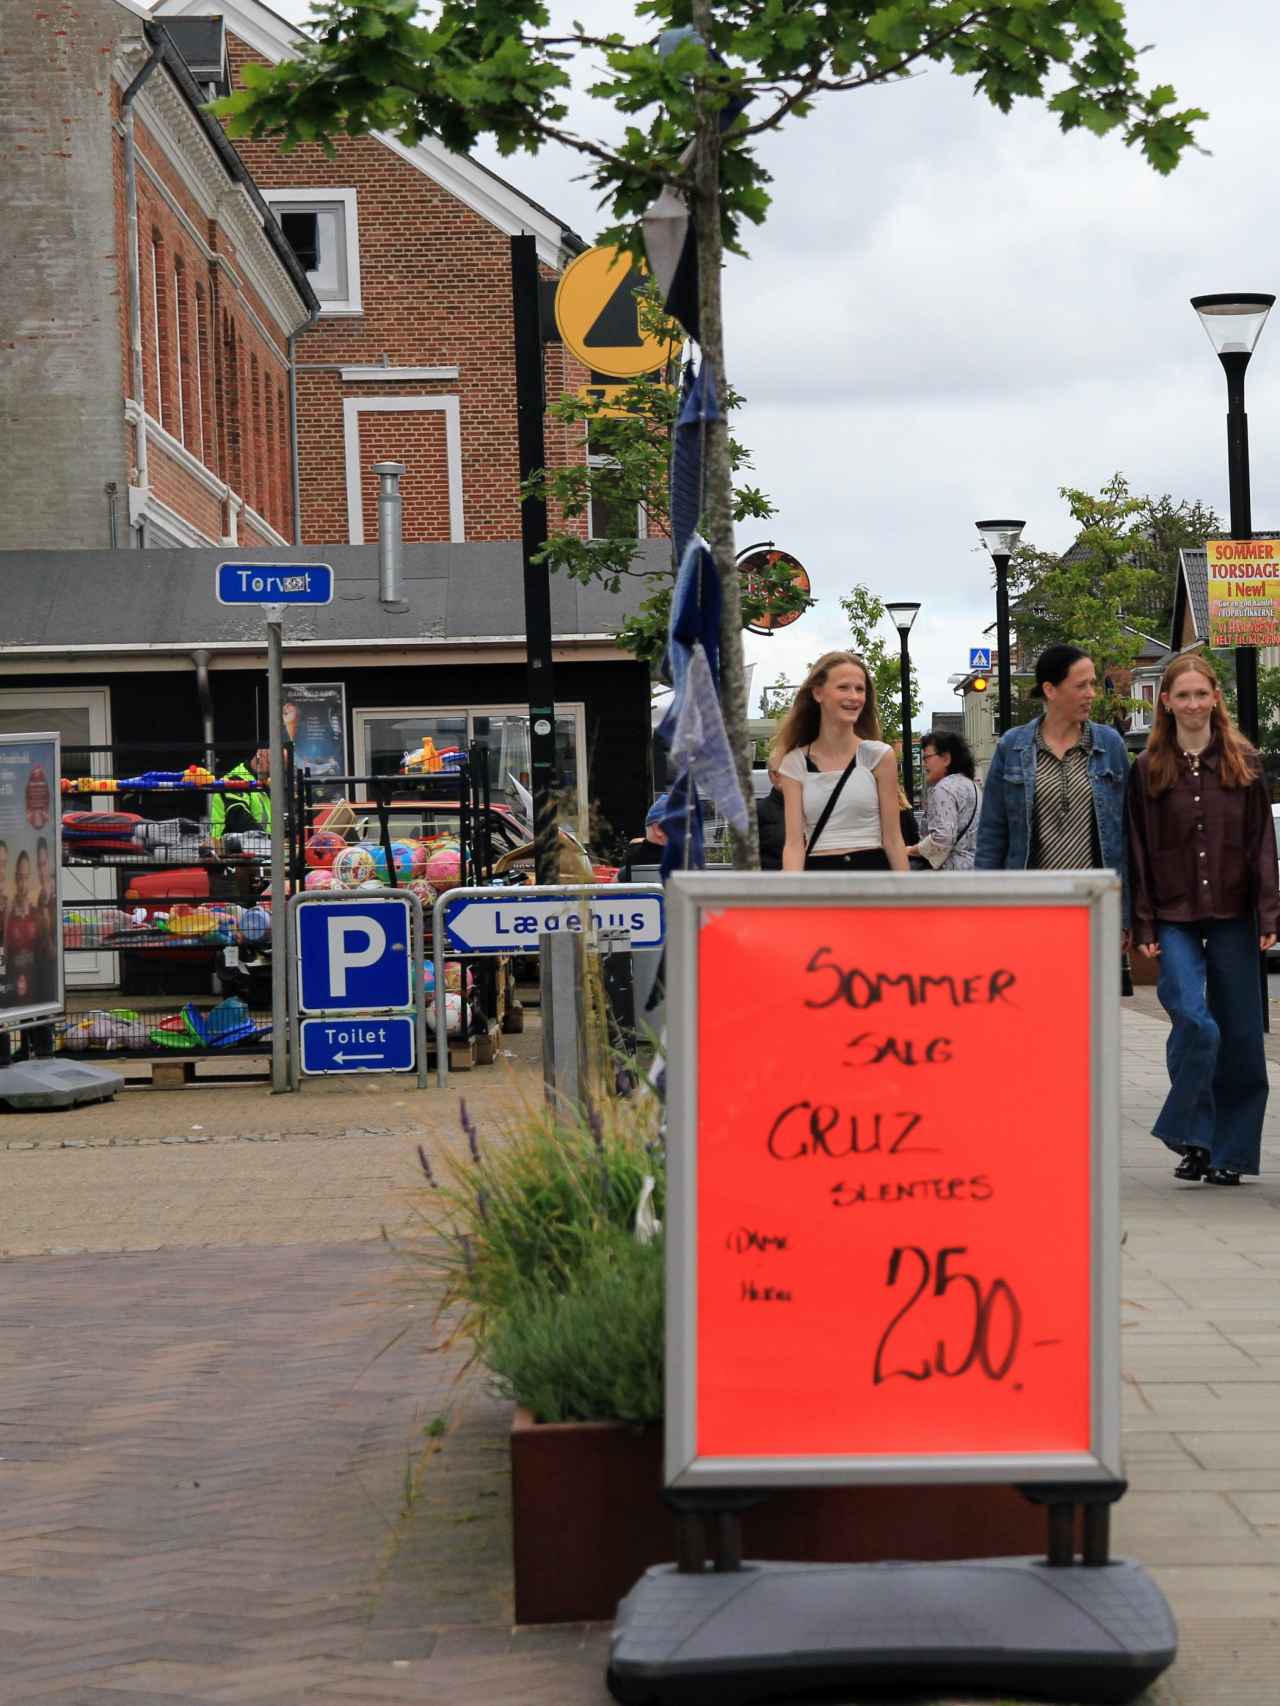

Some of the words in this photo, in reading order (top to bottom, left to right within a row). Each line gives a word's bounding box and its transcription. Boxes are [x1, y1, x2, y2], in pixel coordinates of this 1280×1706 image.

[1215, 544, 1274, 560] SOMMER
[236, 570, 311, 592] Torvt
[1210, 563, 1280, 579] TORSDAGE
[327, 915, 386, 998] P
[803, 947, 1018, 1008] SOMMER
[324, 1027, 387, 1045] Toilet
[842, 1032, 953, 1067] SALG
[767, 1100, 943, 1160] CRUZ
